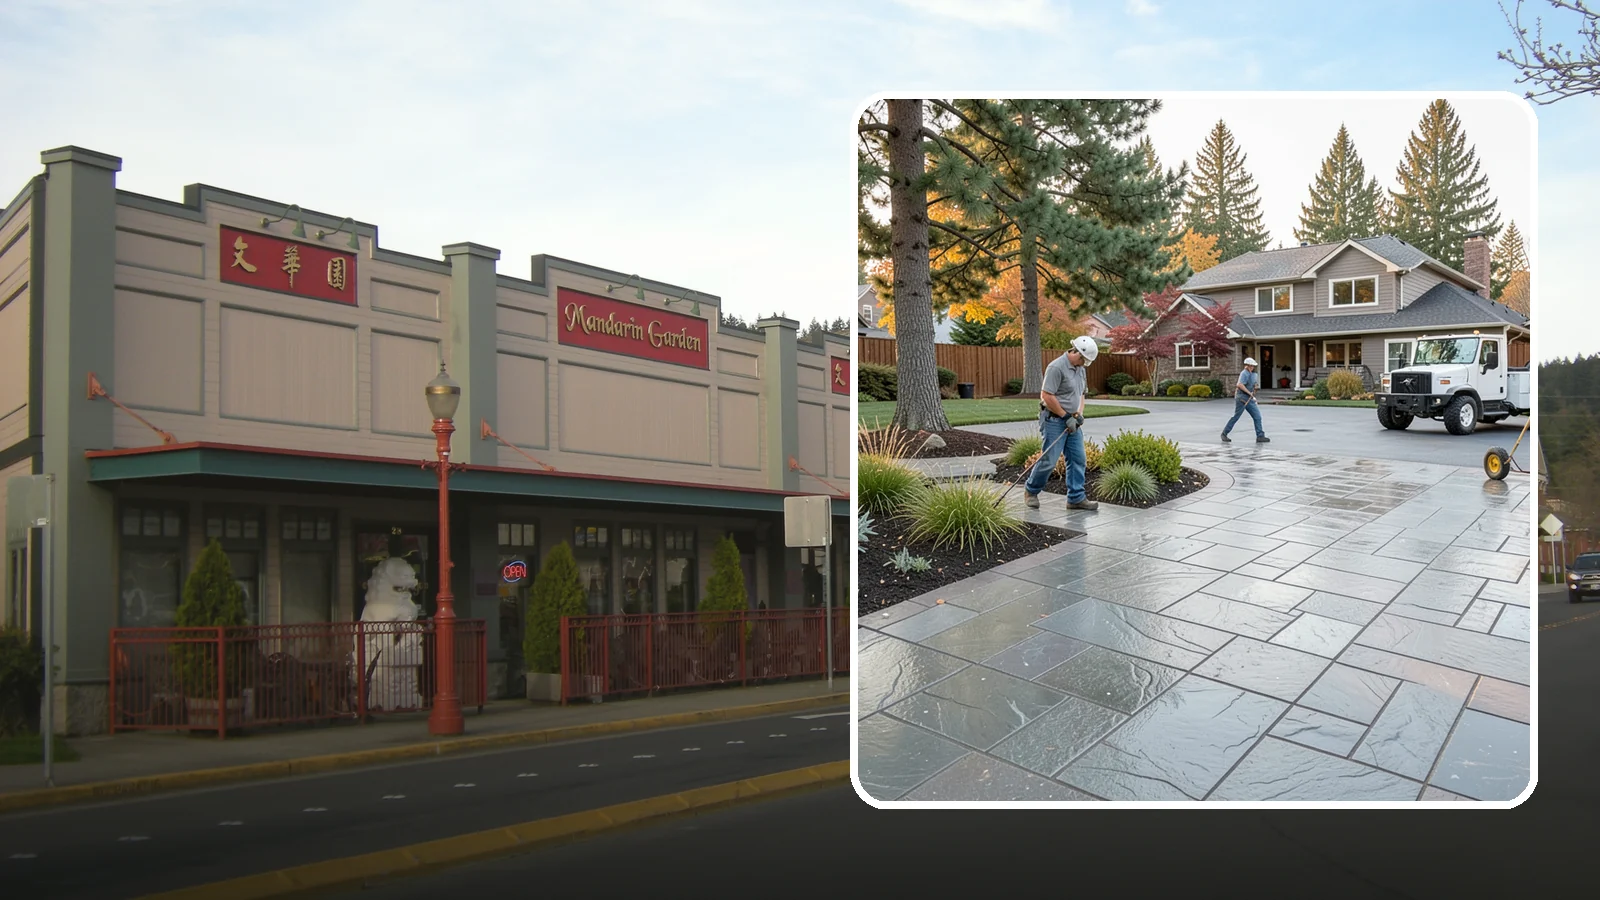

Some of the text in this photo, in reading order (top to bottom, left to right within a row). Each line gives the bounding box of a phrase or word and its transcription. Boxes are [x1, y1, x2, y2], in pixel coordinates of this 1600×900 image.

[231, 235, 346, 291] 文華園
[564, 302, 701, 352] Mandarin Garden
[503, 565, 527, 578] OPEN
